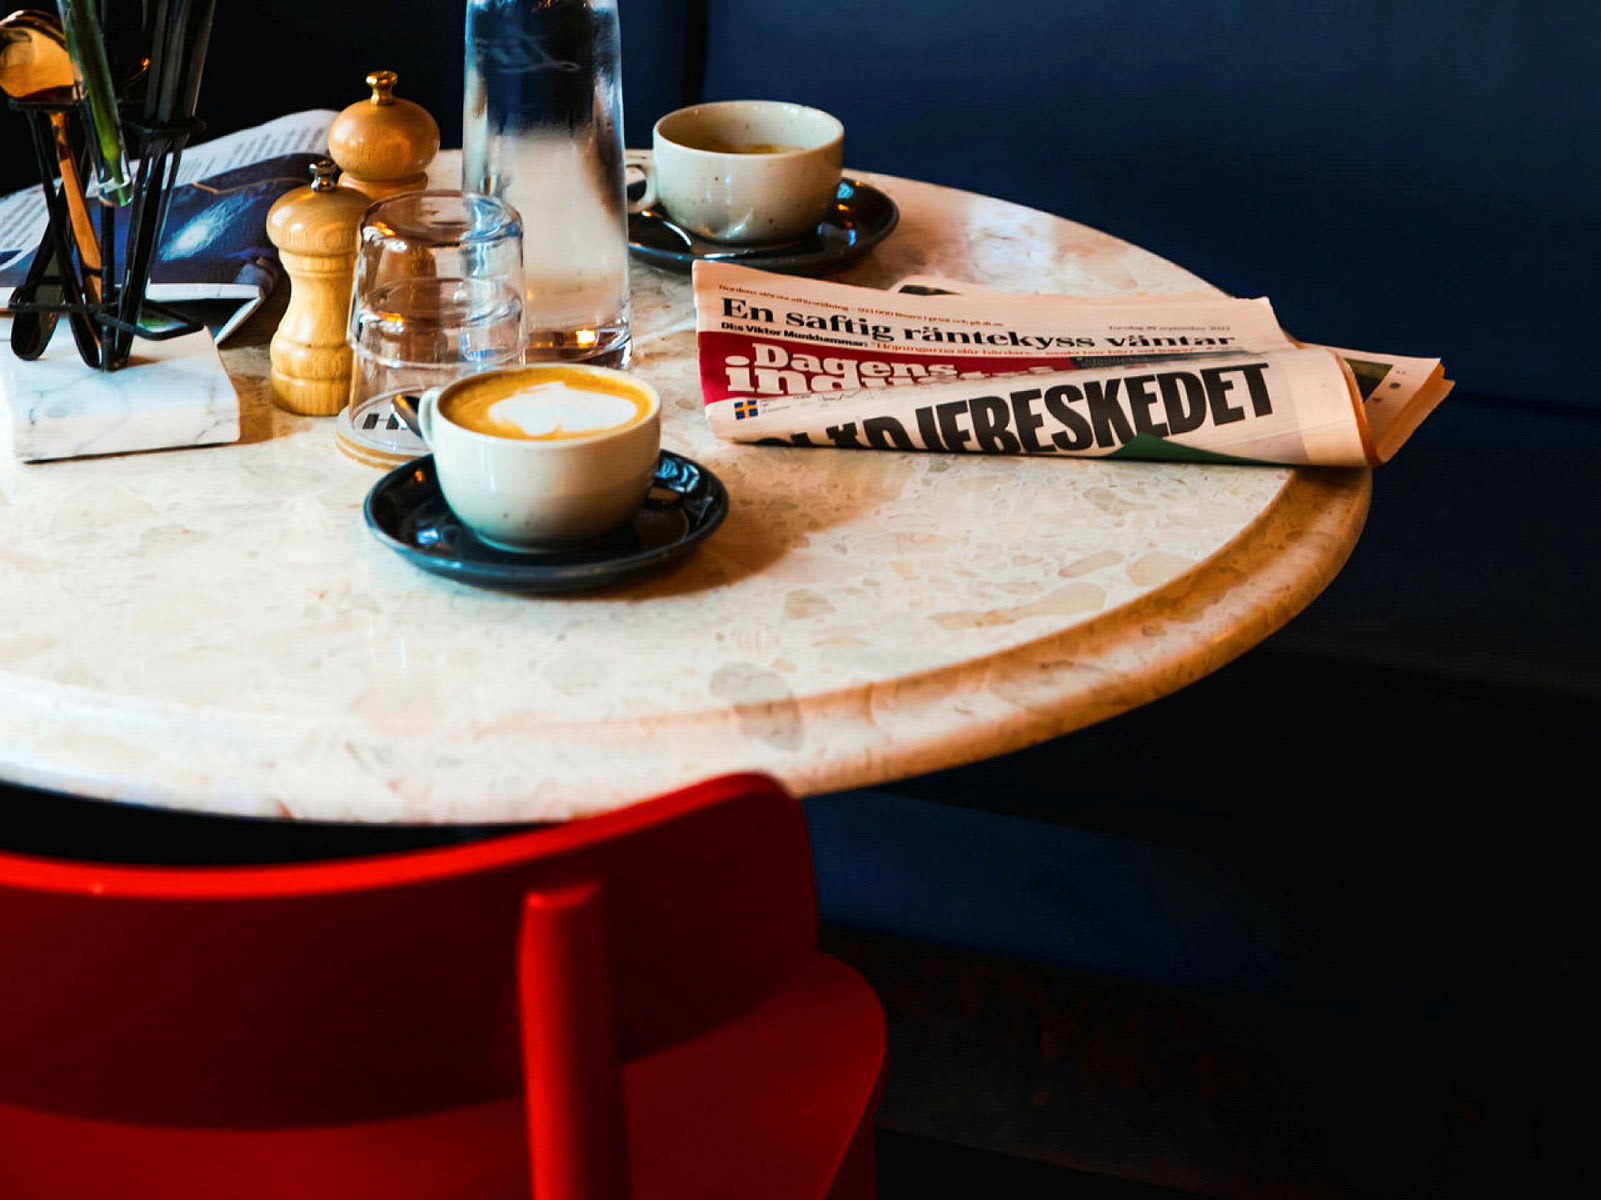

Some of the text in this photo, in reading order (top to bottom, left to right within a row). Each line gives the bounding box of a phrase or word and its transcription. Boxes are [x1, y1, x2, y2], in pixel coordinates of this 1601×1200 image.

[722, 297, 1236, 351] En saftig räntekyss väntar
[745, 324, 782, 337] Viktor
[752, 342, 958, 378] Dagens
[755, 362, 1274, 452] DJEBESKEDET
